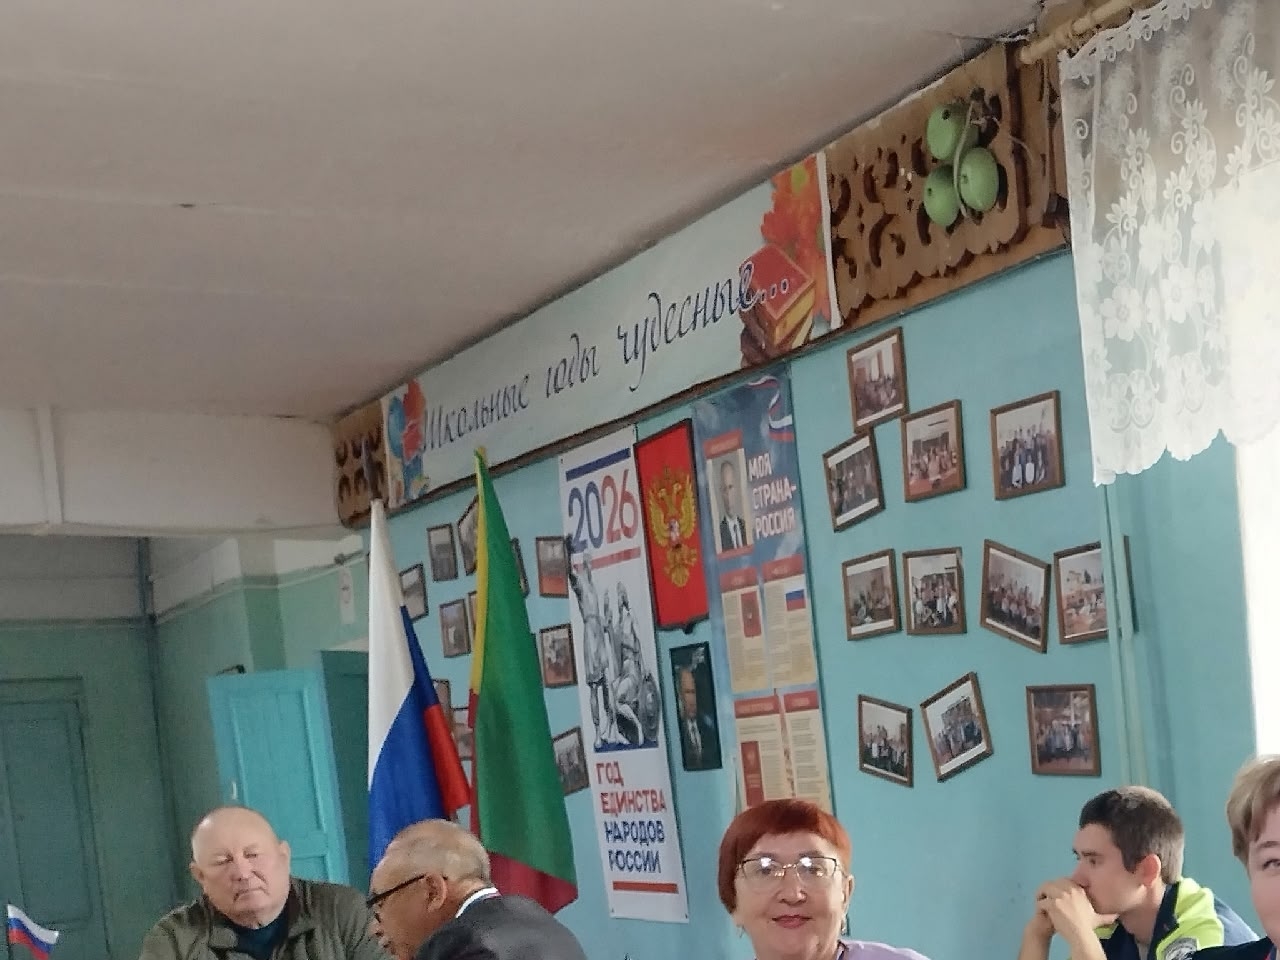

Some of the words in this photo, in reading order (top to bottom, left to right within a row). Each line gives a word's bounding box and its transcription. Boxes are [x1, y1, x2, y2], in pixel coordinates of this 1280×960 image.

[546, 333, 600, 398] годы
[748, 452, 772, 483] МОЯ
[568, 468, 639, 554] 2026
[754, 507, 796, 539] РОССИЯ
[596, 761, 624, 787] ГОД
[600, 788, 668, 816] ЕДИНСТВА
[604, 820, 666, 847] НАРОДОВ
[609, 850, 662, 875] РОССИИ
